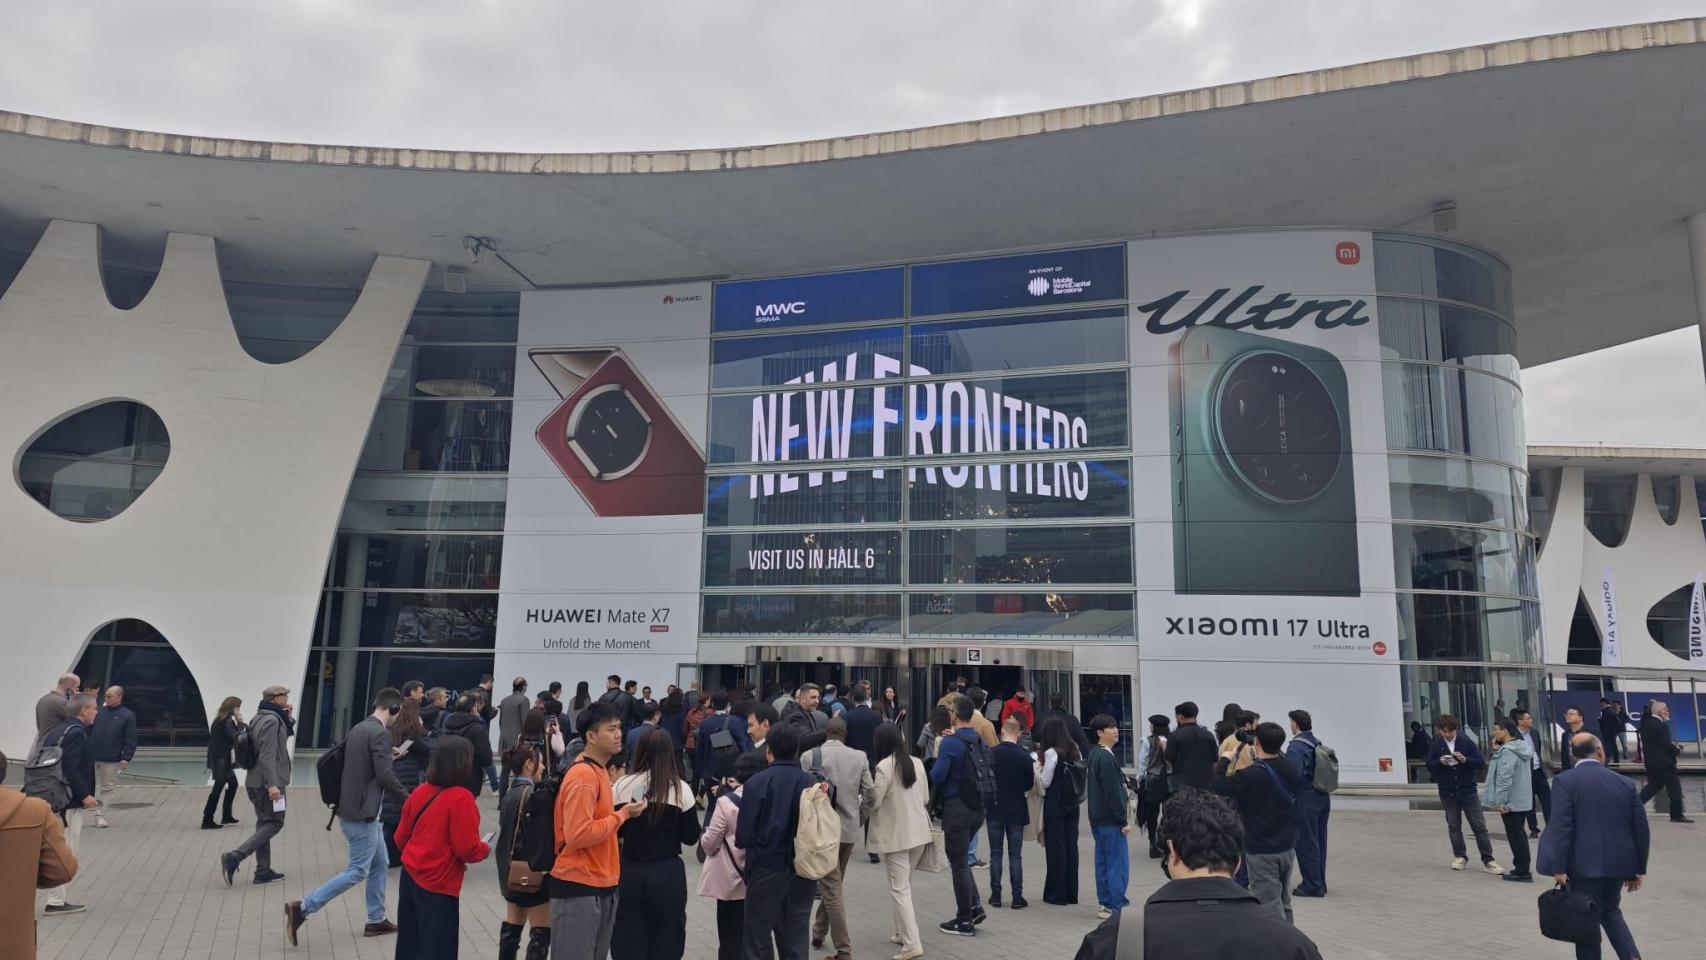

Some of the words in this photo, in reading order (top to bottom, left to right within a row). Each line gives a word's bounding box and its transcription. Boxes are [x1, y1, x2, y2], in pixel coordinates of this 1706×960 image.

[1053, 287, 1083, 295] Barcelona
[675, 295, 703, 303] HUAWEI
[756, 302, 805, 316] MWC
[1137, 285, 1370, 334] Ultra
[750, 352, 857, 499] NEW
[872, 352, 1089, 501] FRONTIERS
[748, 550, 782, 570] VISIT
[786, 549, 804, 570] US
[808, 549, 823, 569] IN
[828, 548, 861, 569] HALL
[865, 548, 875, 569] 6
[526, 609, 601, 623] HUAWEI
[607, 609, 646, 623] Mate
[651, 608, 670, 623] X7
[1287, 620, 1308, 637] 17
[1317, 620, 1370, 638] Ultra
[543, 638, 579, 649] Unfold
[583, 638, 601, 649] the
[604, 638, 651, 649] Moment
